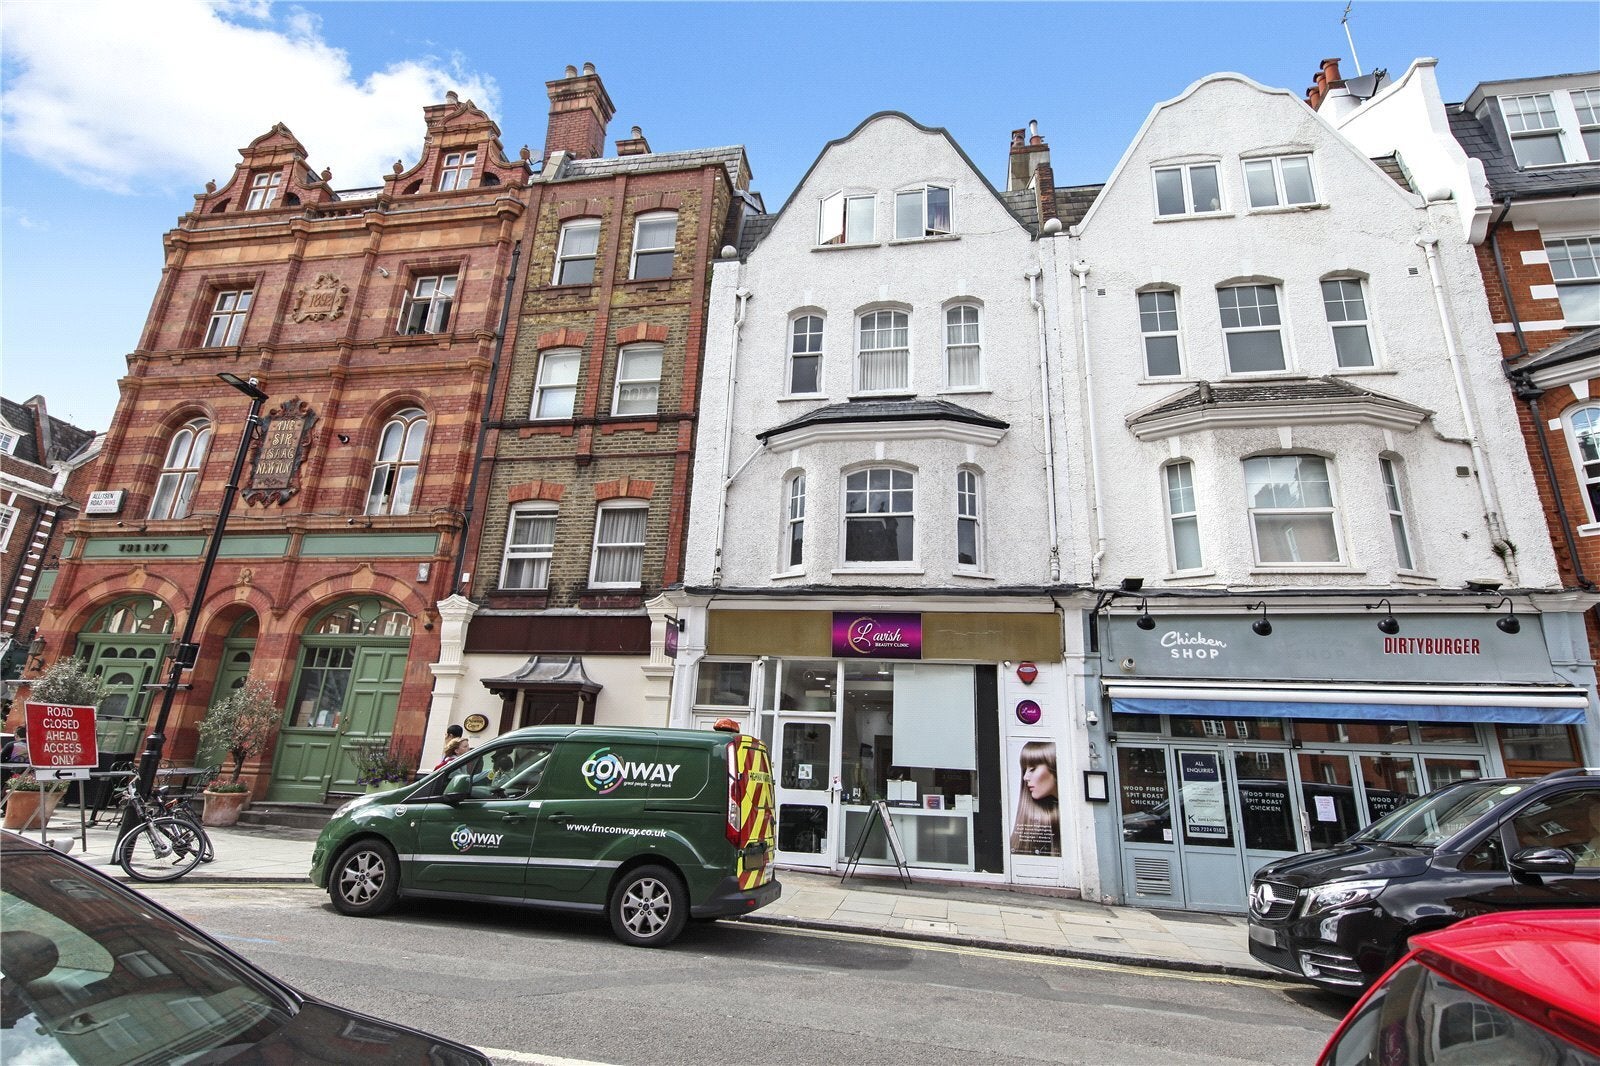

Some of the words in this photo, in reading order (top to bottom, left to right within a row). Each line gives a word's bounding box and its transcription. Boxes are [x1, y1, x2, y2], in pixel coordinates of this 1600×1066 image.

[277, 420, 296, 430] THE
[272, 433, 293, 445] SIR
[1160, 630, 1228, 648] Chicken
[1384, 636, 1480, 656] DIRTYBURGER
[1170, 648, 1220, 660] SHOP
[47, 706, 74, 718] ROAD
[42, 718, 80, 730] CLOSED
[45, 730, 79, 741] AHEAD
[43, 742, 82, 753] ACCESS
[51, 754, 75, 766] ONLY
[581, 759, 681, 782] CONWAY
[566, 822, 668, 838] www.fmconway.co.uk
[450, 831, 504, 845] CONWAY
